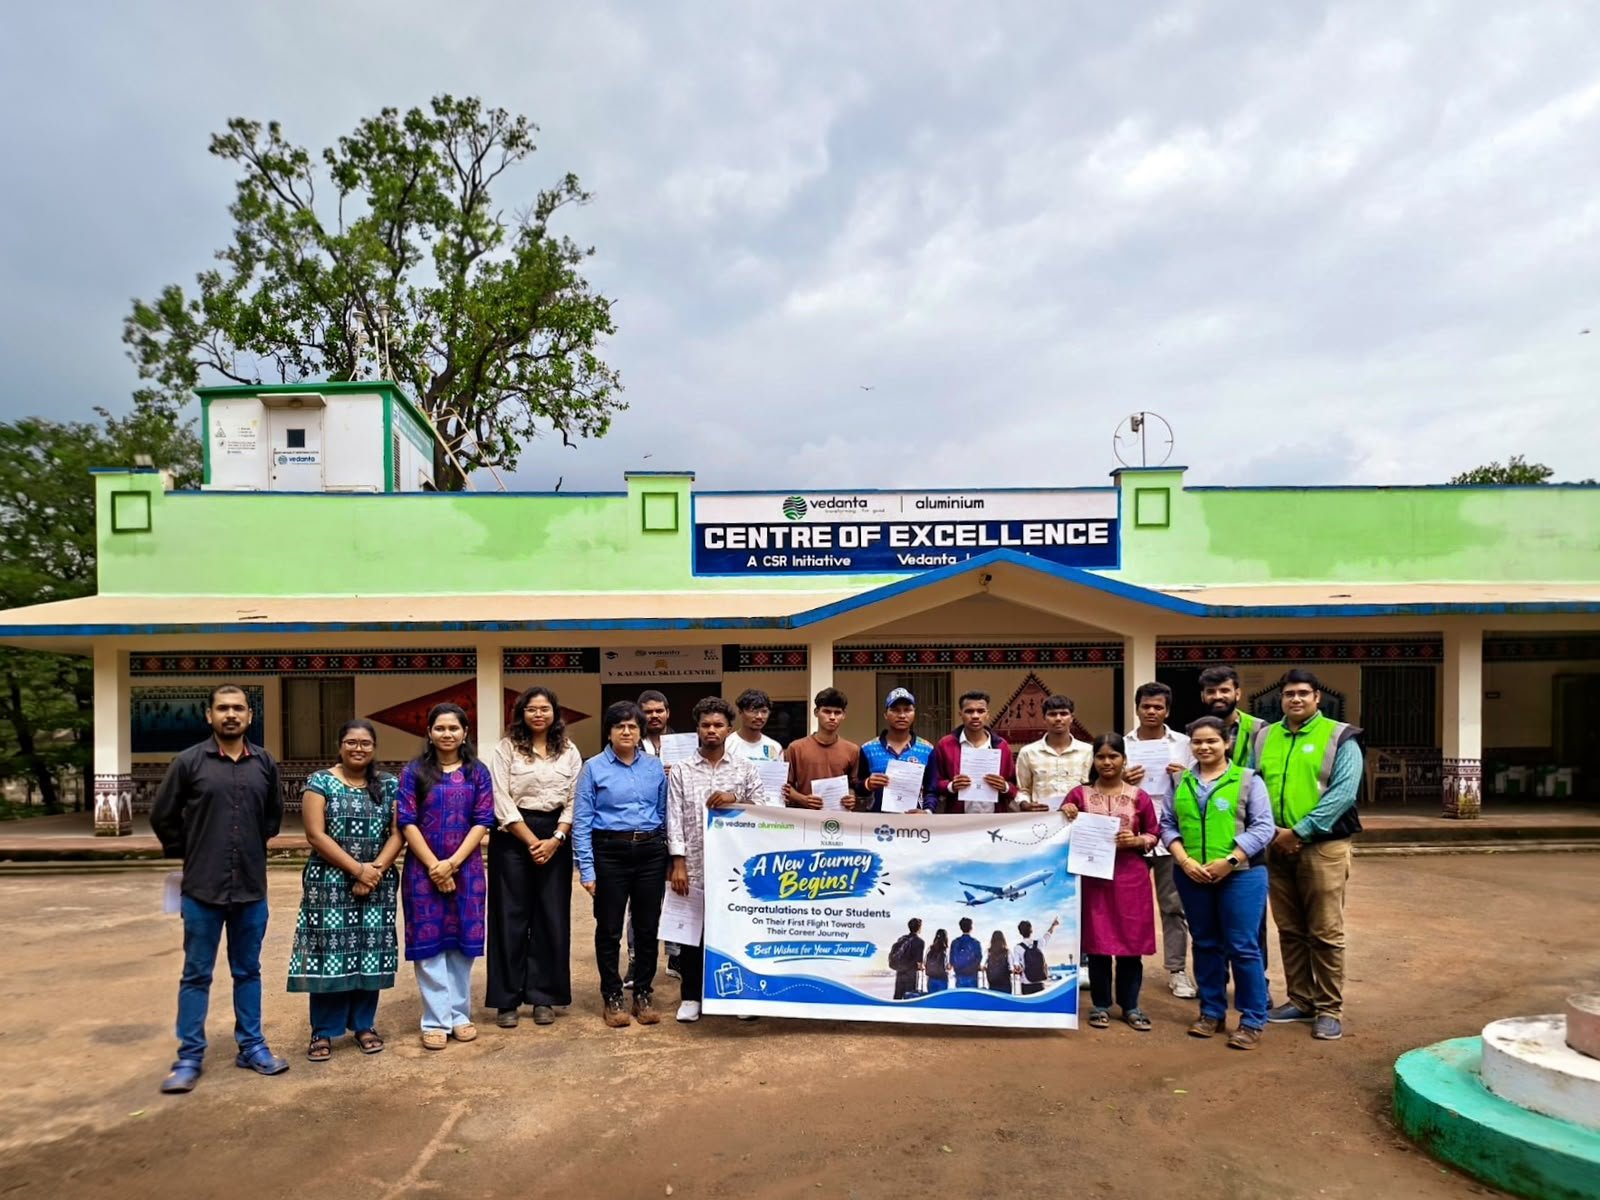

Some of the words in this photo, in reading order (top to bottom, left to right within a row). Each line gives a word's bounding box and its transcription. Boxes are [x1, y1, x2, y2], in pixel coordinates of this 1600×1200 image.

[810, 496, 867, 509] vedanta
[915, 497, 984, 509] aluminium
[704, 526, 832, 549] CENTRE
[839, 525, 882, 548] OF
[889, 522, 1108, 547] EXCELLENCE
[747, 556, 757, 567] A
[763, 555, 787, 567] CSR
[792, 554, 851, 567] Initiative
[897, 554, 957, 565] Vedanta
[725, 820, 756, 828] vedanta
[758, 821, 795, 829] aluminium
[897, 828, 930, 843] mng
[753, 856, 767, 876] A
[772, 854, 805, 873] New
[809, 852, 872, 873] Journey
[778, 868, 859, 899] Begins!
[728, 903, 808, 915] Congratulations
[812, 907, 821, 915] to
[824, 907, 842, 916] Our
[846, 908, 891, 918] Students
[766, 918, 785, 926] Their
[807, 919, 829, 929] Flight
[832, 921, 865, 929] Towards
[789, 928, 815, 936] Career
[818, 930, 849, 939] Journey
[753, 945, 770, 955] Best
[773, 945, 799, 955] Wishes
[801, 945, 811, 955] for
[814, 945, 831, 955] Your
[834, 944, 869, 955] Journey!
